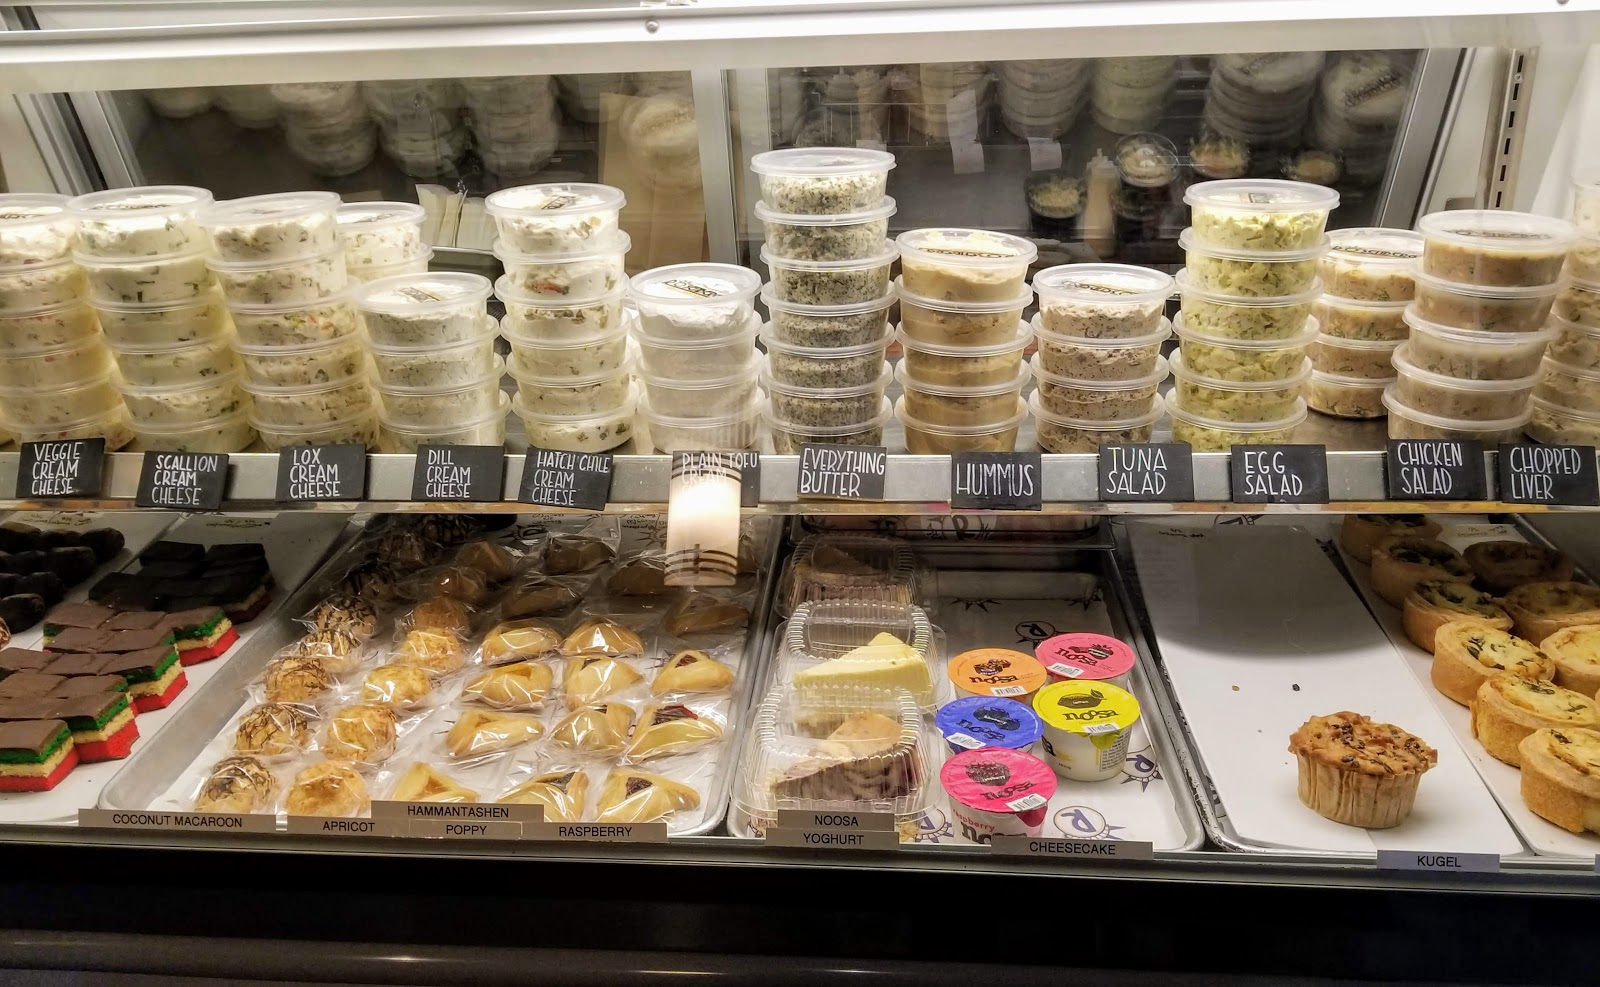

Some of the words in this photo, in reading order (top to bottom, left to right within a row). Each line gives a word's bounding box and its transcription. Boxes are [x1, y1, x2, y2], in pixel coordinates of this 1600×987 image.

[34, 441, 82, 461] VEGGIE
[293, 448, 321, 465] LOX
[428, 450, 455, 466] DILL
[1107, 447, 1167, 472] TUNA
[1398, 442, 1463, 468] CHICKEN
[32, 459, 78, 480] CREAM
[155, 454, 218, 473] SCALLION
[537, 451, 577, 470] HATCH
[579, 453, 610, 474] CHILE
[682, 452, 721, 470] PLAIN
[727, 452, 757, 469] TOFU
[802, 447, 885, 476] EVERYTHING
[1244, 451, 1285, 474] EGG
[1510, 447, 1581, 475] CHOPPED
[154, 470, 197, 487] CREAM
[289, 464, 339, 483] CREAM
[426, 466, 471, 485] CREAM
[533, 470, 575, 490] CREAM
[956, 463, 1034, 497] HUMMUS
[1401, 467, 1452, 495] SALAD
[31, 476, 74, 496] CHEESE
[289, 481, 341, 499] CHEESE
[425, 482, 470, 499] CHEESE
[800, 470, 861, 498] BUTTER
[1107, 471, 1167, 496] SALAD
[1244, 474, 1303, 497] SALAD
[1510, 474, 1554, 500] LIVER
[151, 486, 202, 506] CHEESE
[531, 488, 576, 507] CHEESE
[1062, 709, 1119, 721] noosa
[980, 781, 1037, 801] noosa
[112, 814, 171, 827] COCONUT
[174, 815, 242, 828] MACAROON
[407, 805, 509, 818] HAMMANTASHEN
[814, 814, 859, 827] NOOSA
[953, 808, 996, 833] raspberry
[322, 820, 375, 833] APRICOT
[446, 825, 488, 836] POPPY
[559, 826, 633, 838] RASPBERRY
[803, 832, 864, 846] YOGHURT
[1029, 841, 1116, 855] CHEESECAKE
[1417, 856, 1462, 868] KUGEL
